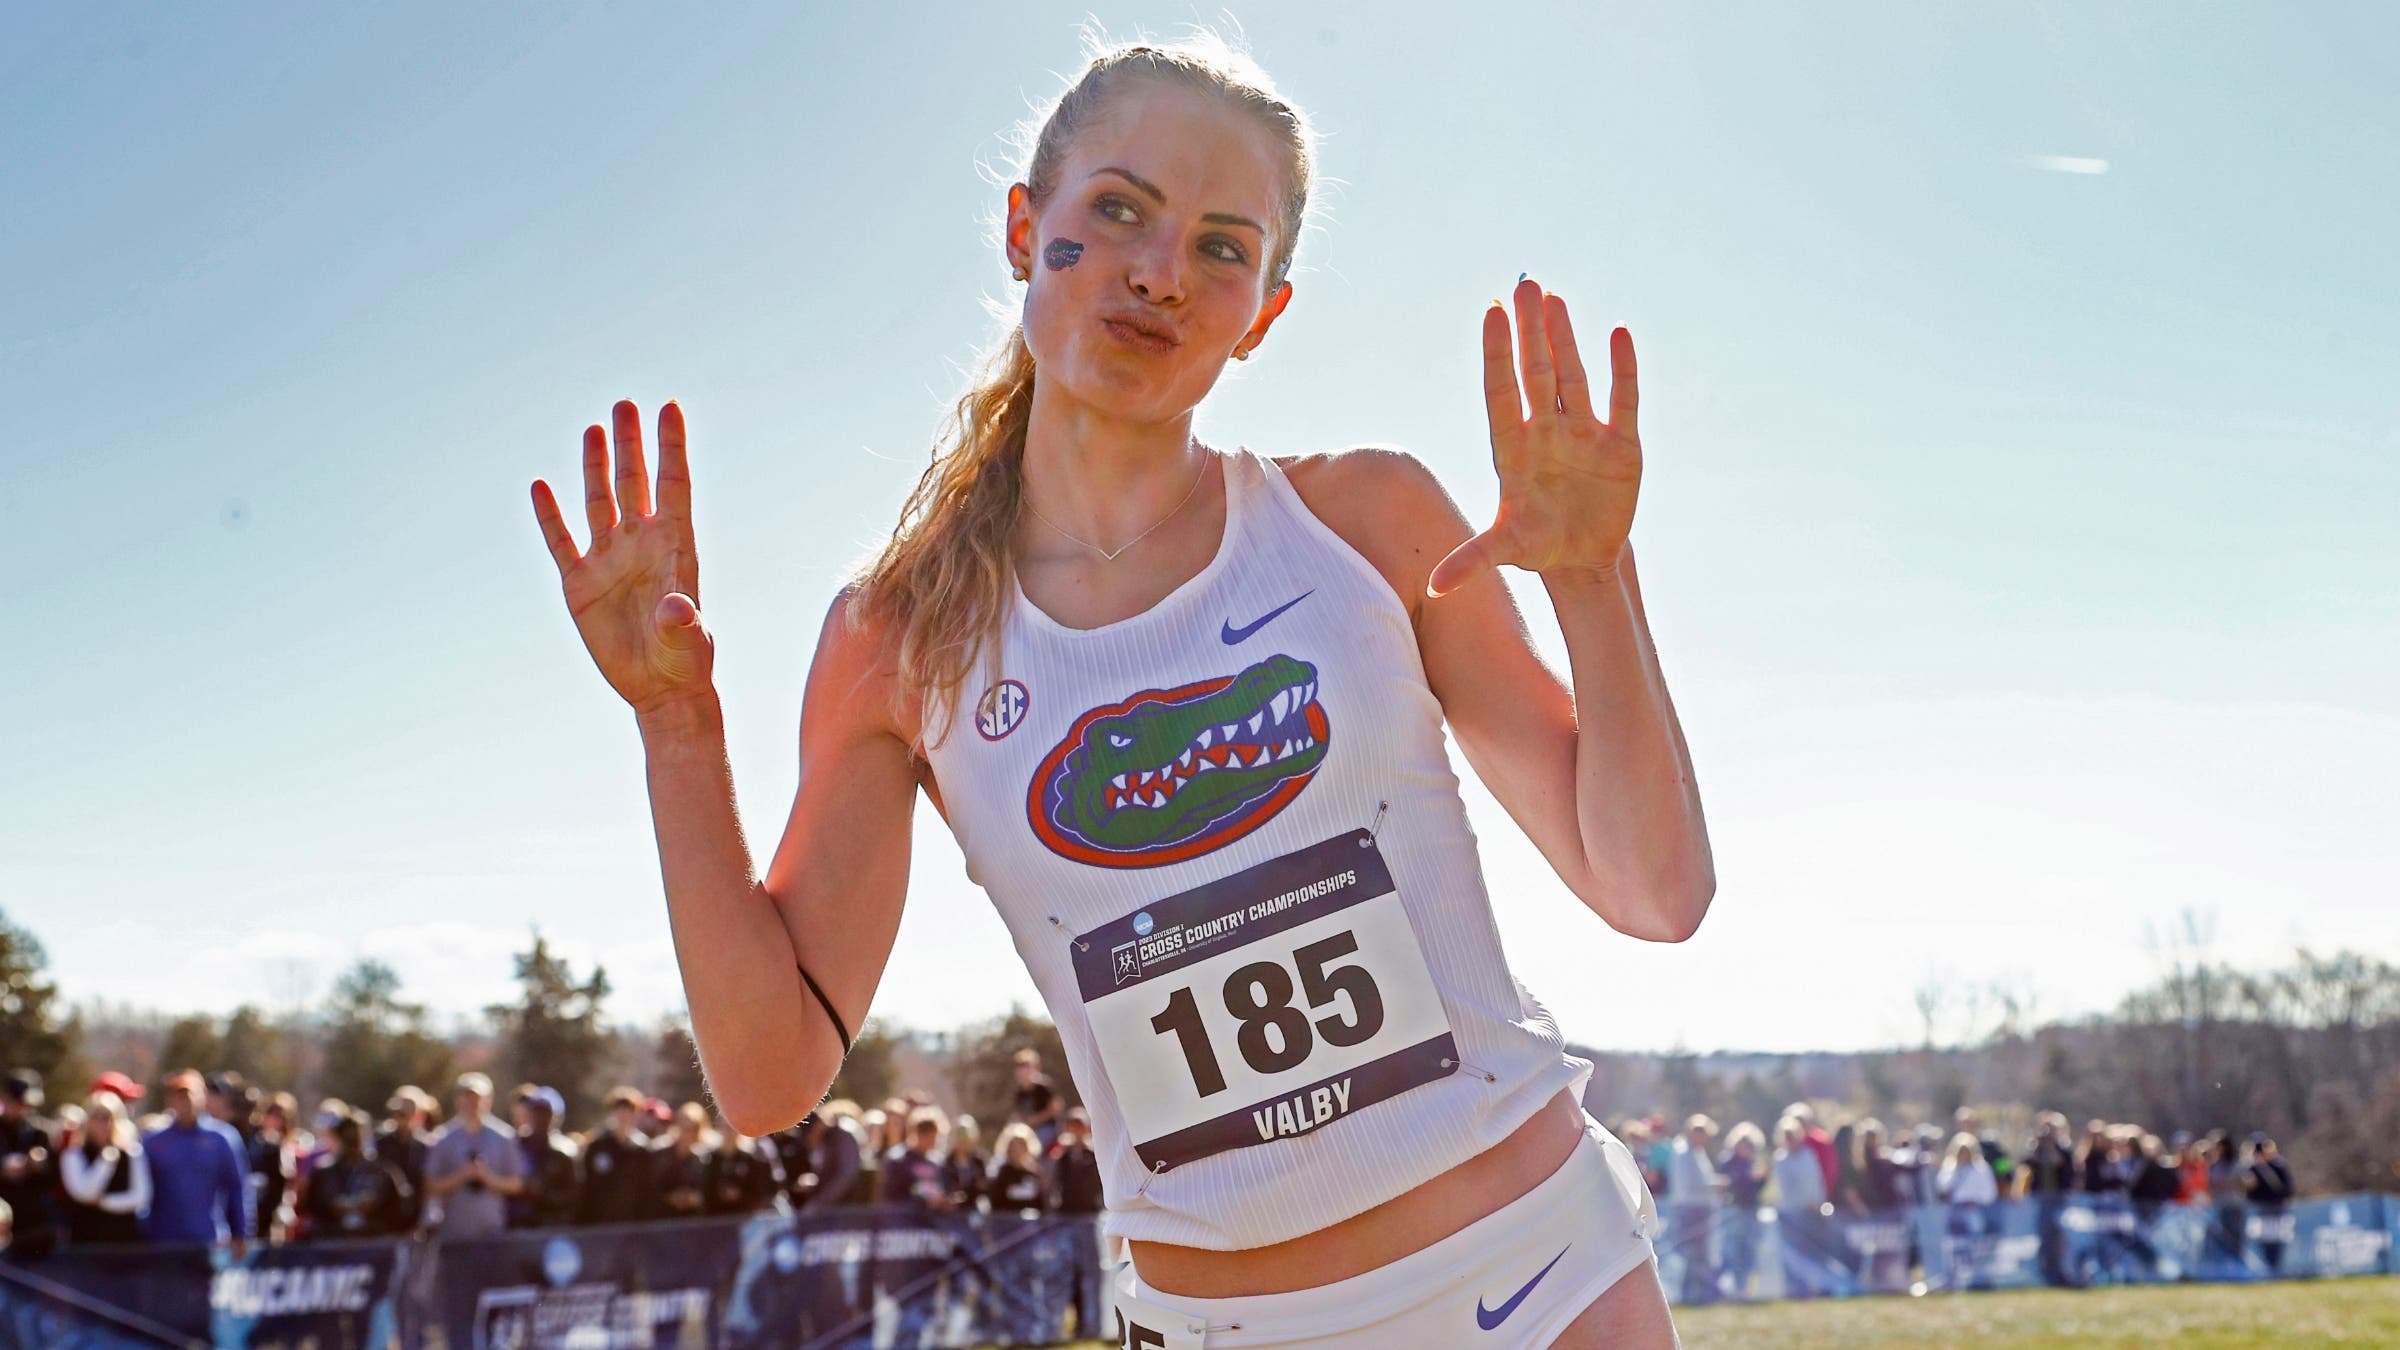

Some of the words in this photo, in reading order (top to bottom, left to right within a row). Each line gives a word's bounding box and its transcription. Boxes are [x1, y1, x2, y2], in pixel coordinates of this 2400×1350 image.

[979, 683, 1026, 737] SEC
[1140, 933, 1183, 961] CROSS
[1186, 910, 1245, 944] COUNTRY
[1249, 870, 1356, 922] CHAMPIONSHIPS
[1153, 925, 1180, 941] DIVISION
[1150, 929, 1384, 1098] 185
[1253, 1077, 1352, 1141] VALBY
